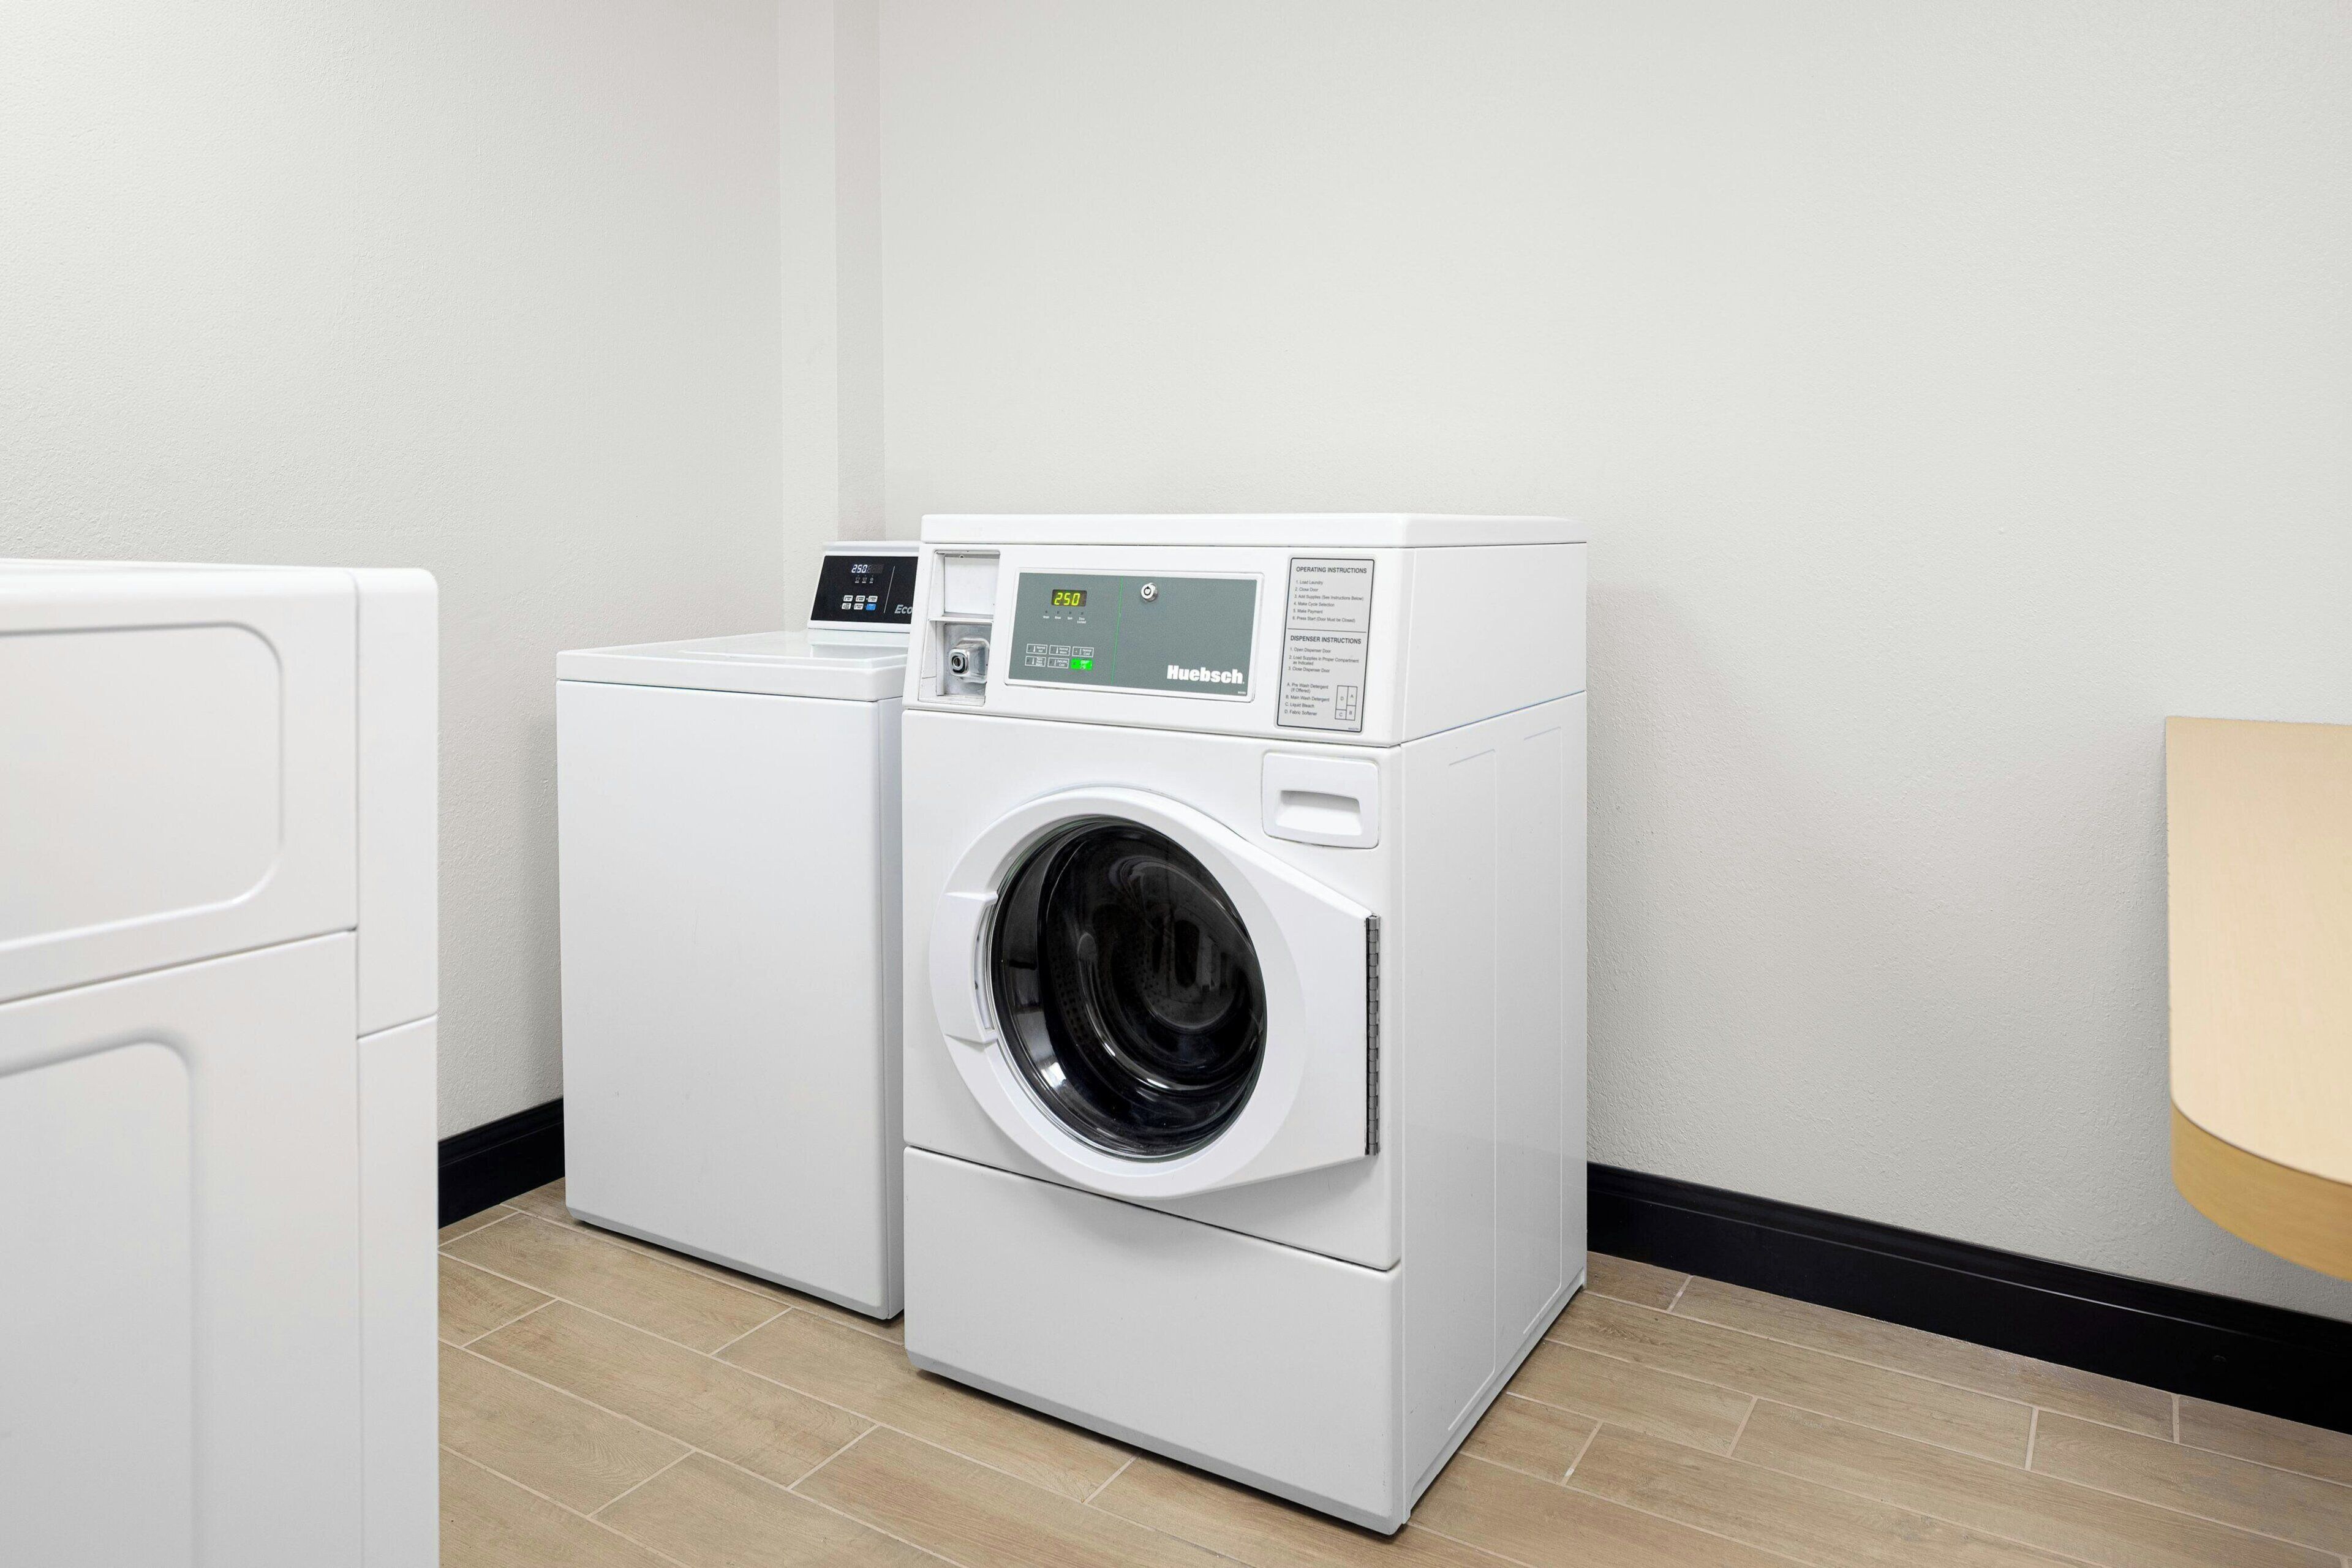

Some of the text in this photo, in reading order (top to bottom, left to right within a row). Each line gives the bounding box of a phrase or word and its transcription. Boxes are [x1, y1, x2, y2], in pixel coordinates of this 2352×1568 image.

[851, 564, 868, 573] 250
[1054, 592, 1080, 606] 250
[1166, 665, 1245, 684] Huebsch
